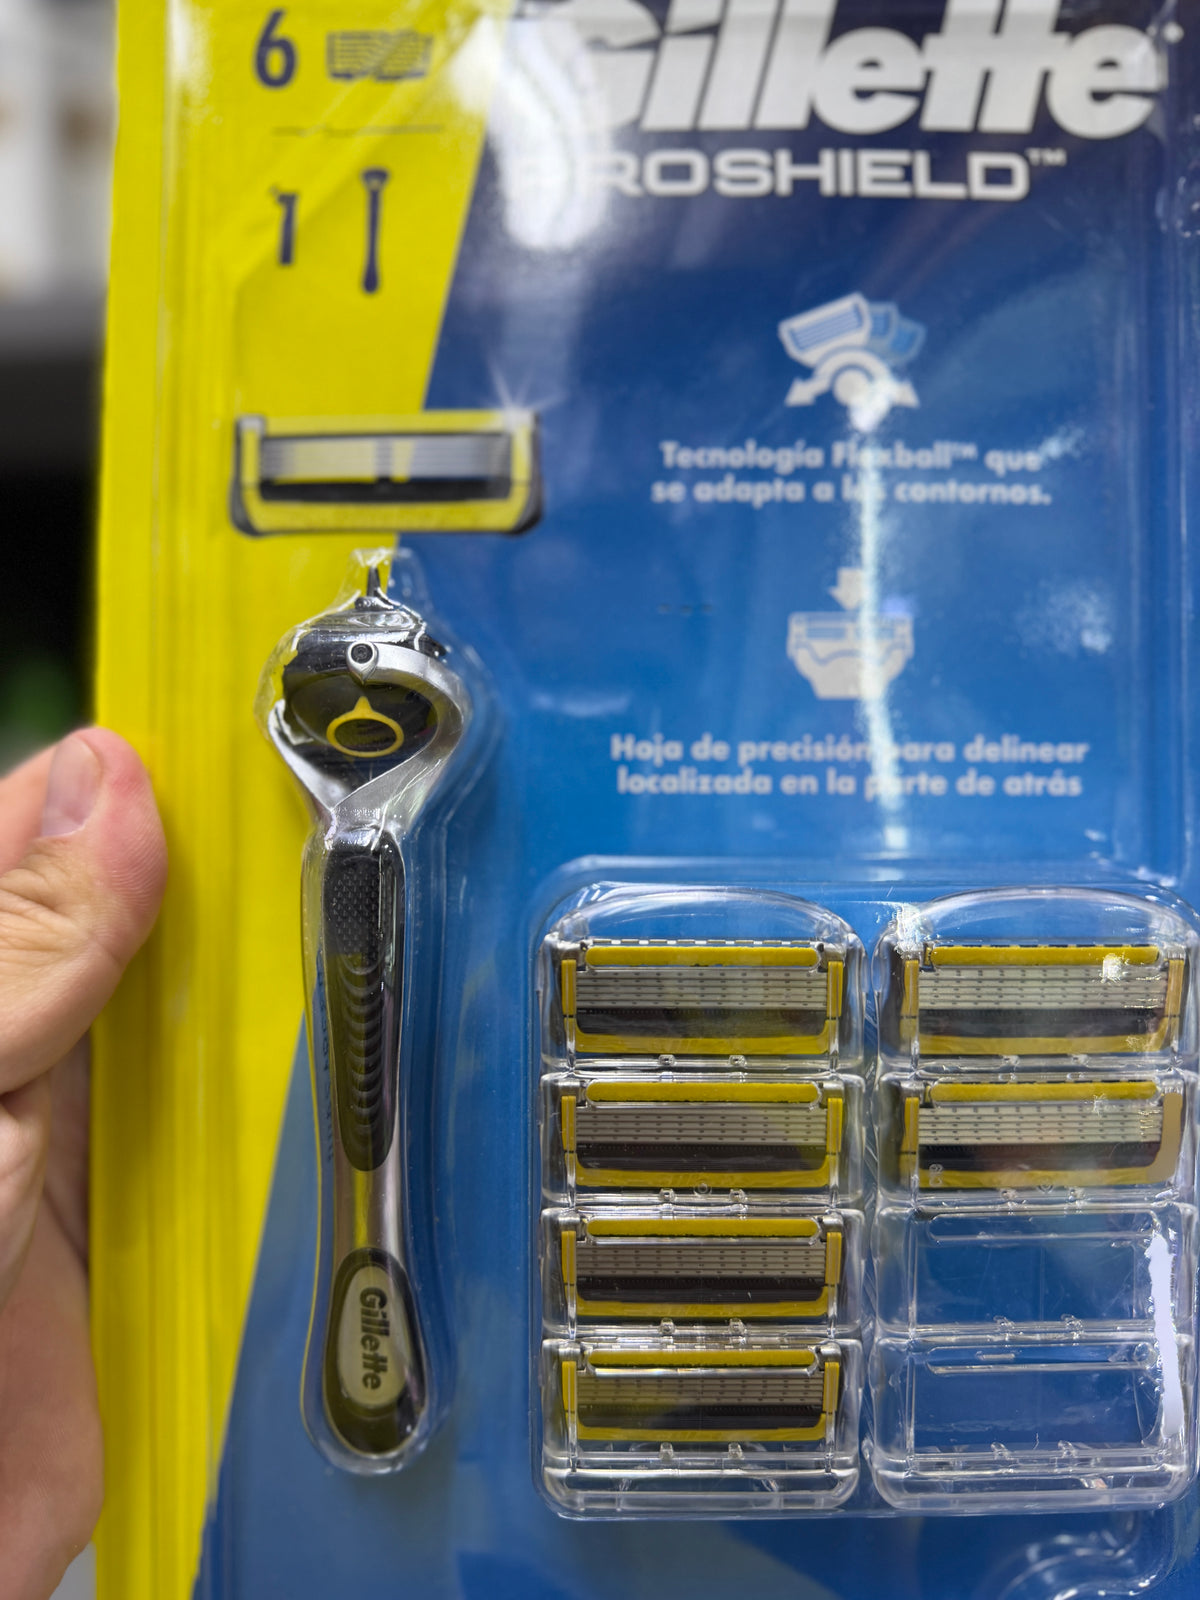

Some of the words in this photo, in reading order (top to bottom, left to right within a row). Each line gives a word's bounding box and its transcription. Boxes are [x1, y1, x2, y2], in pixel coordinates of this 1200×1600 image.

[254, 9, 296, 88] 6
[270, 185, 298, 266] 1
[660, 438, 825, 475] Tecnología
[984, 449, 1041, 477] que
[651, 480, 687, 503] se
[692, 473, 805, 510] adapta
[811, 481, 835, 503] a
[895, 478, 1051, 505] contornos.
[610, 732, 684, 768] Hoja
[690, 732, 730, 761] de
[737, 733, 869, 768] precisión
[963, 734, 1089, 763] delinear
[616, 765, 772, 795] localizada
[780, 774, 819, 795] en
[826, 767, 856, 795] la
[956, 768, 996, 797] de
[1003, 768, 1082, 797] atrás
[360, 1287, 389, 1390] Gillette
